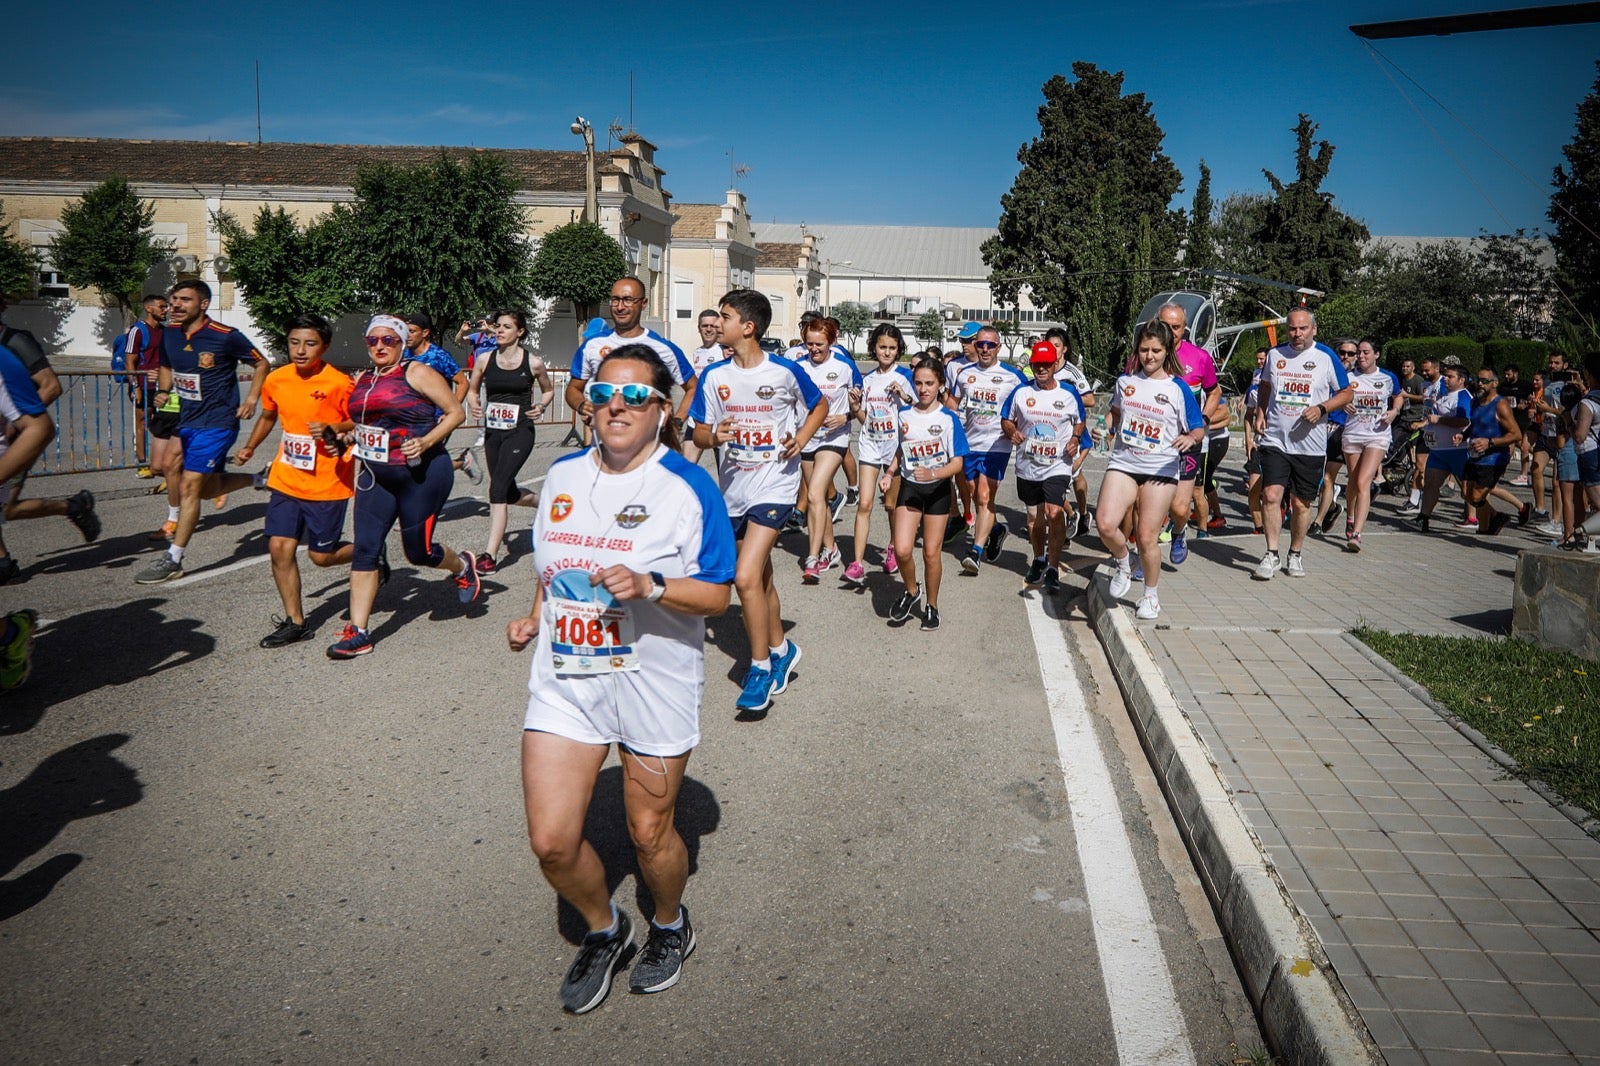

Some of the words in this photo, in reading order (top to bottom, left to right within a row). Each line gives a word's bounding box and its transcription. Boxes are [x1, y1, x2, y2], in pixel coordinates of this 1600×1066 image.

[1285, 381, 1310, 394] 1068
[974, 390, 996, 402] 1156
[490, 407, 513, 420] 1186
[869, 420, 893, 431] 1118
[1130, 420, 1161, 440] 1162
[734, 429, 773, 446] 1134
[284, 439, 312, 456] 1192
[909, 442, 940, 458] 1157
[1031, 444, 1057, 457] 1150
[547, 531, 583, 547] CARRERA
[584, 535, 606, 549] BASE
[606, 538, 634, 552] AEREA
[556, 615, 621, 647] 1081
